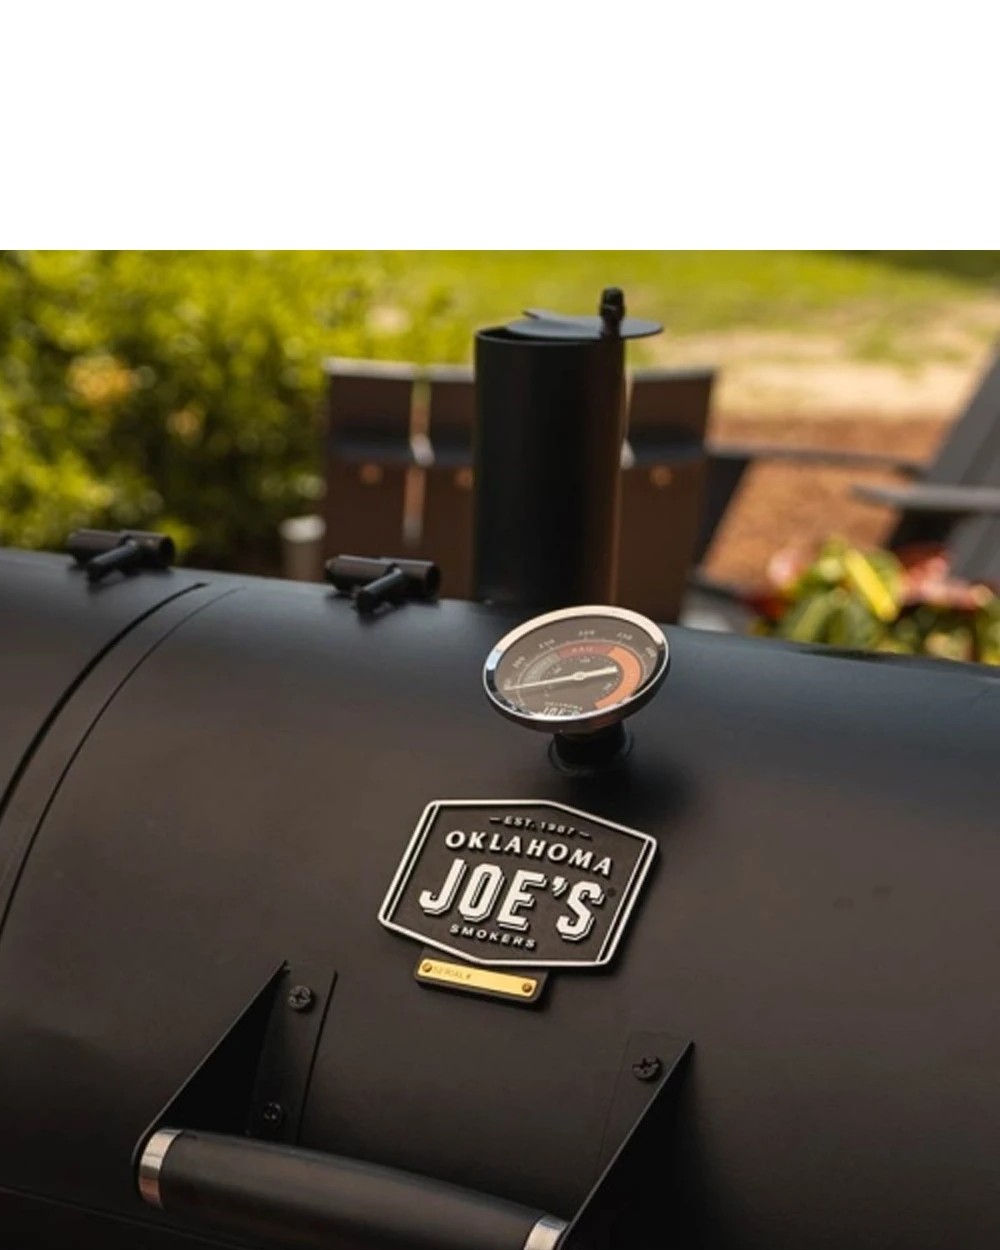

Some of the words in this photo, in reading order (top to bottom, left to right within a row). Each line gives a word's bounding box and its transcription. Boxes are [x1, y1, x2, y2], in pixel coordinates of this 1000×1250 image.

[445, 830, 614, 877] OKLAHOMA
[419, 858, 605, 942] JOE'S
[450, 923, 537, 950] SMOKERS
